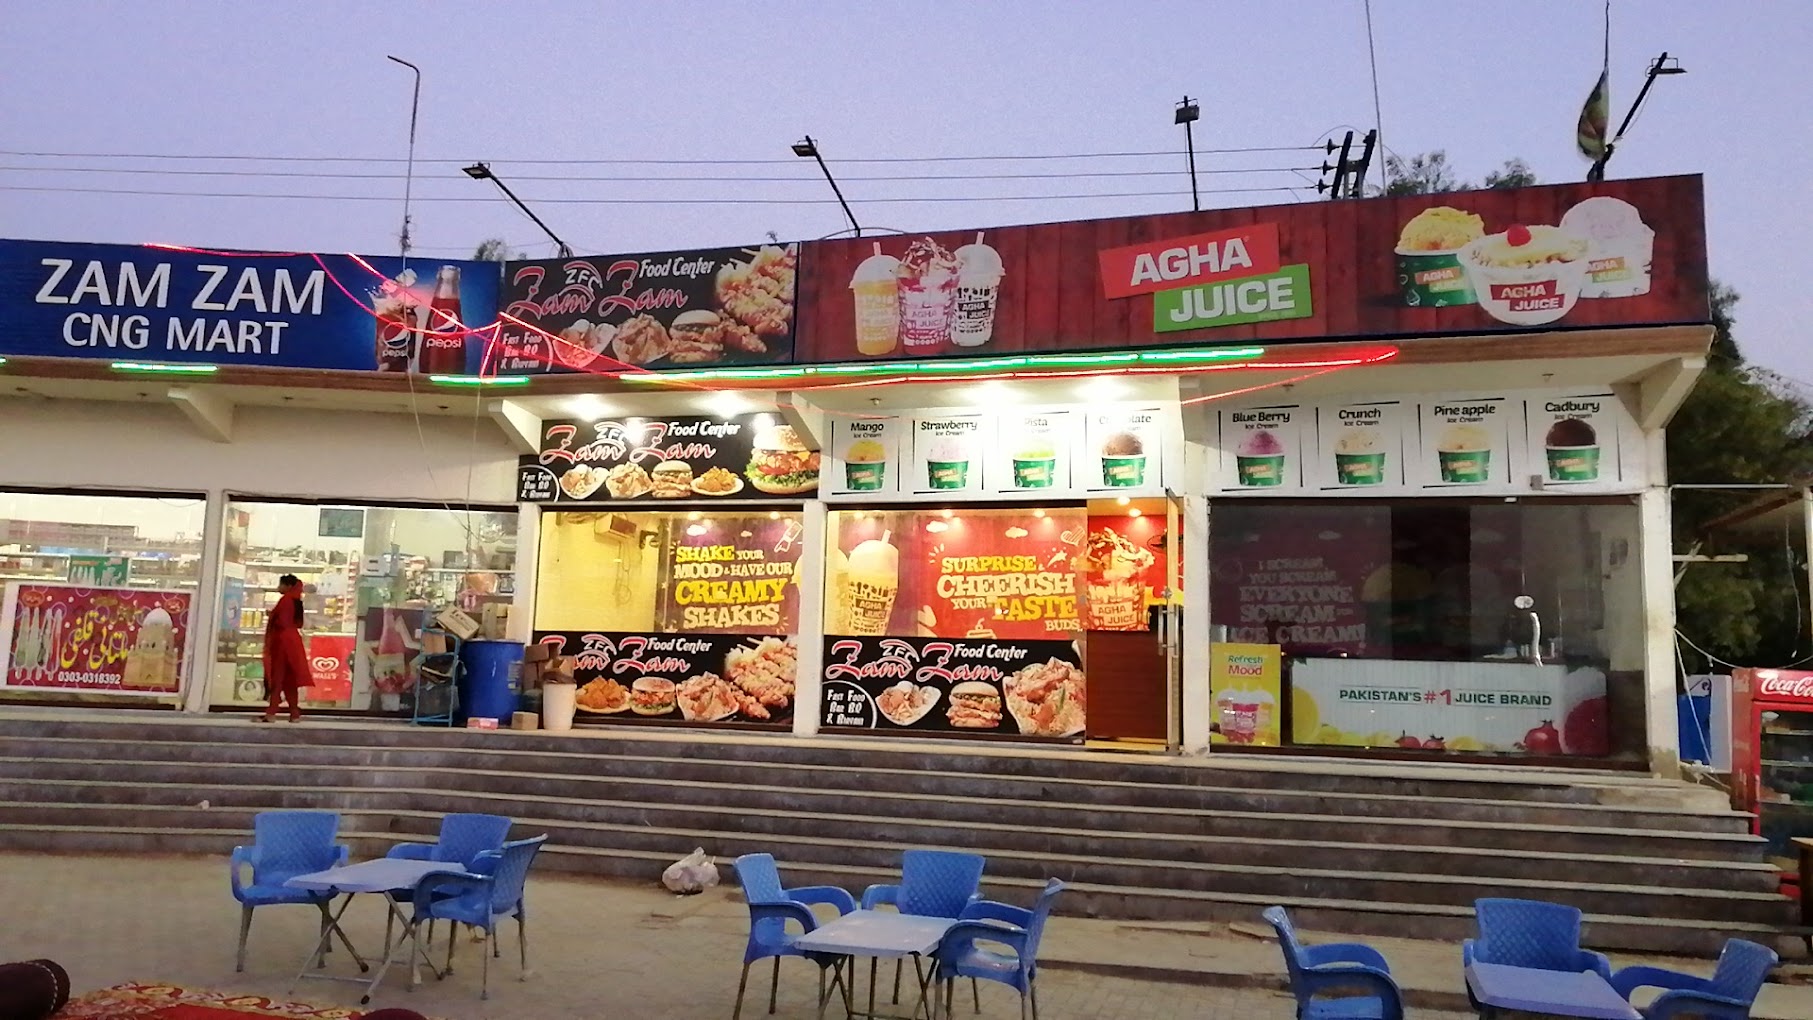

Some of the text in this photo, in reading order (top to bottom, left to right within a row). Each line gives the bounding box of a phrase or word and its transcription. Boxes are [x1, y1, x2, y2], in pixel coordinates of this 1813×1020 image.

[639, 257, 715, 279] Food Center
[1130, 237, 1252, 286] AGHA
[1423, 270, 1454, 282] AGHA
[35, 258, 325, 315] ZAM ZAM
[506, 260, 688, 320] Zam Zam
[1501, 285, 1546, 299] AGHA
[962, 302, 985, 311] AGHA
[1170, 277, 1295, 322] JUICE
[1514, 299, 1559, 311] JUICE
[62, 312, 290, 355] CNG MART
[426, 338, 461, 349] pepsi
[1338, 408, 1381, 420] Crunch
[1434, 404, 1495, 417] Pine apple
[1545, 402, 1600, 413] Cadbury
[921, 420, 977, 431] Strawberry
[1232, 412, 1290, 423] Blue Berry
[668, 421, 741, 438] Food Center
[850, 422, 884, 433] Mango
[539, 422, 716, 465] Zam Zam
[676, 545, 765, 562] SHAKE YOUR
[674, 563, 723, 579] MOOD
[730, 563, 765, 576] HAVE
[766, 562, 793, 575] OUR
[941, 555, 1037, 574] SURPRISE
[675, 578, 788, 605] CREAMY
[937, 572, 1076, 599] CHEERISH
[1239, 585, 1354, 603] EVERYONE
[683, 603, 780, 630] SHAKES
[951, 595, 1078, 622] YOUR TASTE
[1098, 606, 1126, 614] AGHA
[1240, 603, 1337, 623] SCREAM
[1107, 614, 1134, 624] JUICE
[1275, 623, 1367, 648] CREAM!
[647, 637, 712, 654] Food Center
[954, 643, 1028, 662] Food Center
[613, 636, 691, 675] Zam
[825, 639, 1004, 683] Zam Zam
[1228, 655, 1263, 664] Refresh
[1228, 665, 1262, 675] Mood
[1339, 689, 1422, 702] PAKISTAN'S
[1455, 692, 1495, 704] JUICE
[1500, 694, 1552, 706] BRAND
